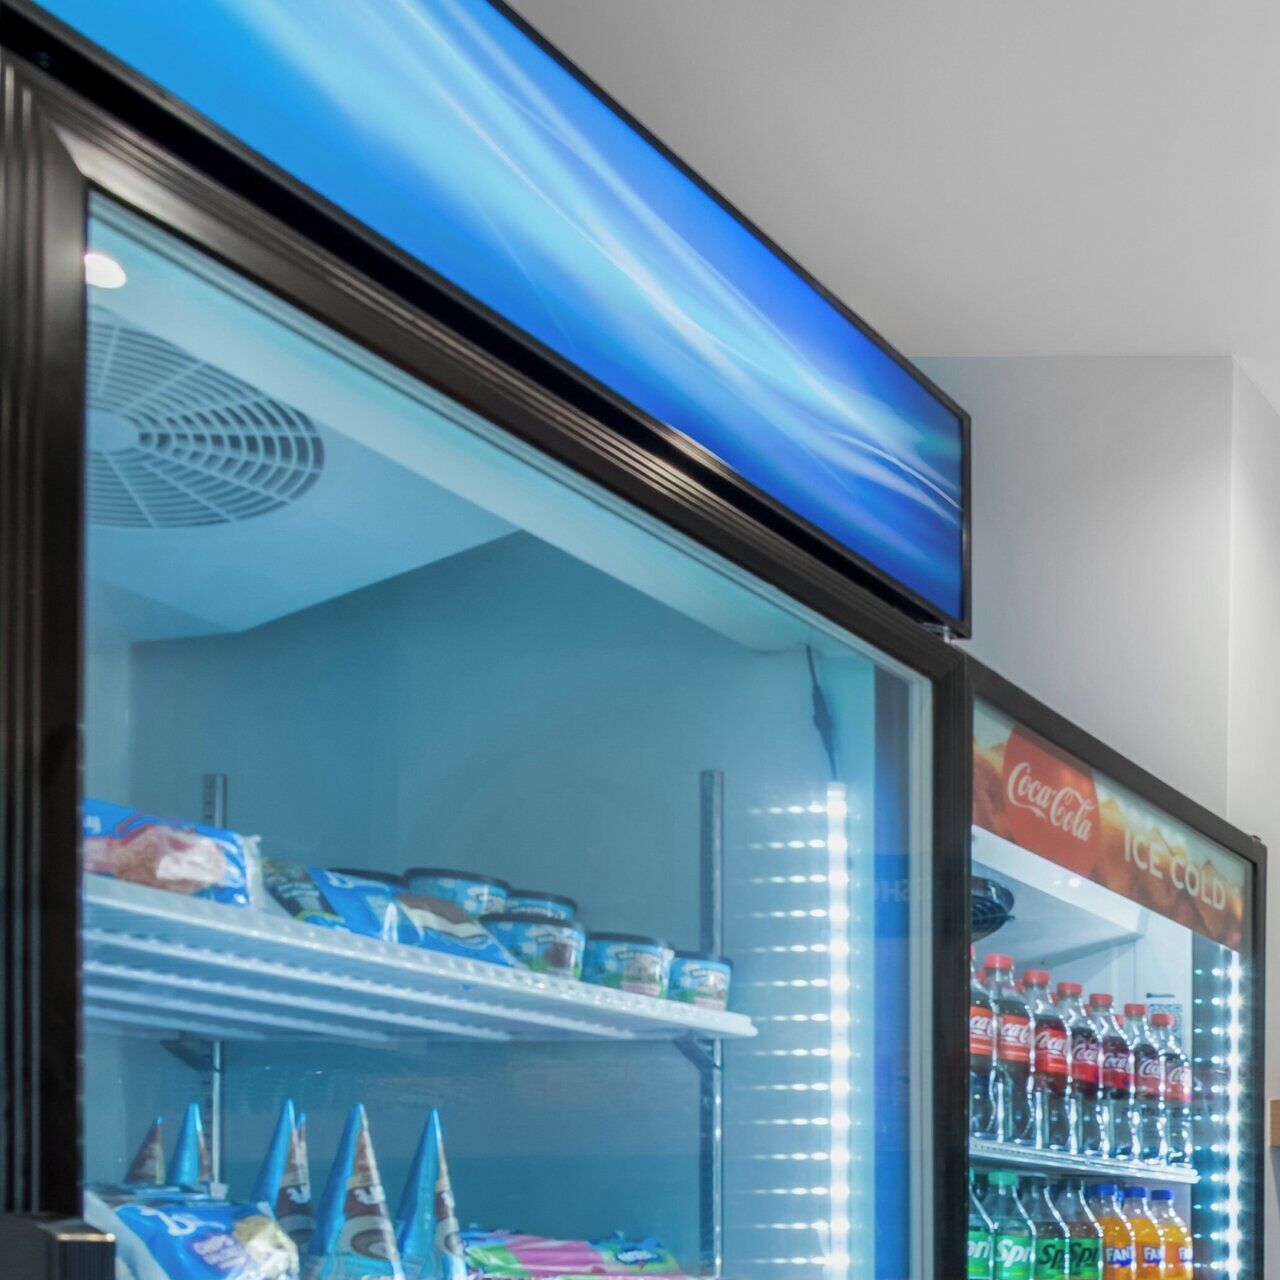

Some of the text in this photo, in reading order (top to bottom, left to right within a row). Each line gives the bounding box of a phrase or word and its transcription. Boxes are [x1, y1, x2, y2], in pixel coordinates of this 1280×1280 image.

[1007, 762, 1095, 841] Coca-Cola
[1123, 829, 1227, 911] ICE COLD
